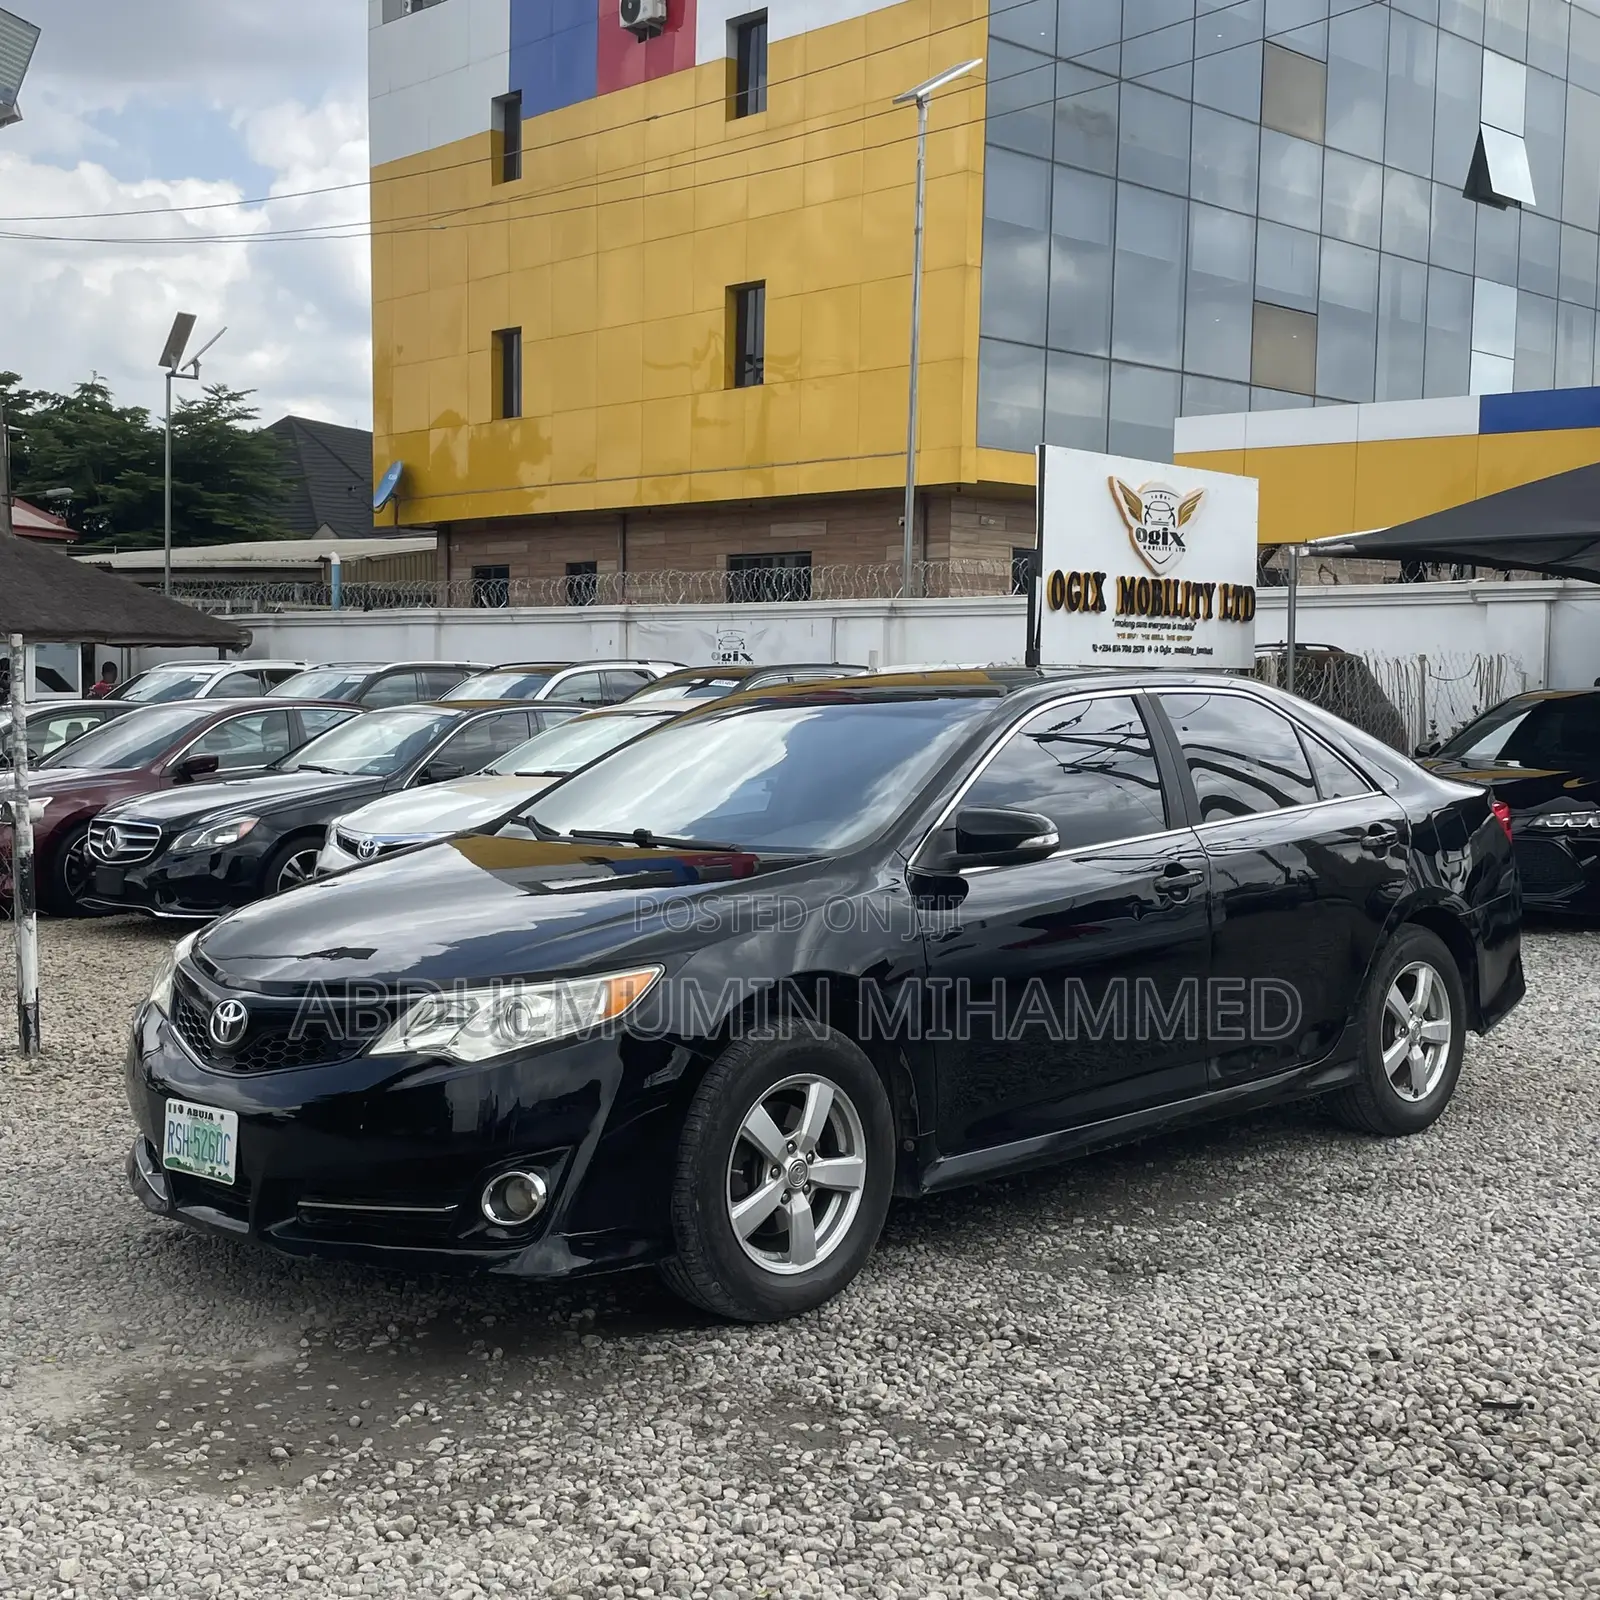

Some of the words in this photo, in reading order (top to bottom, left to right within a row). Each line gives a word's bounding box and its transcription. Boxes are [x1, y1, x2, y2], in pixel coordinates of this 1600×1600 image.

[1047, 569, 1107, 612] OGIX
[1115, 575, 1217, 620] MOBILITY
[1218, 582, 1256, 622] LTD
[187, 1107, 214, 1121] ABUJA
